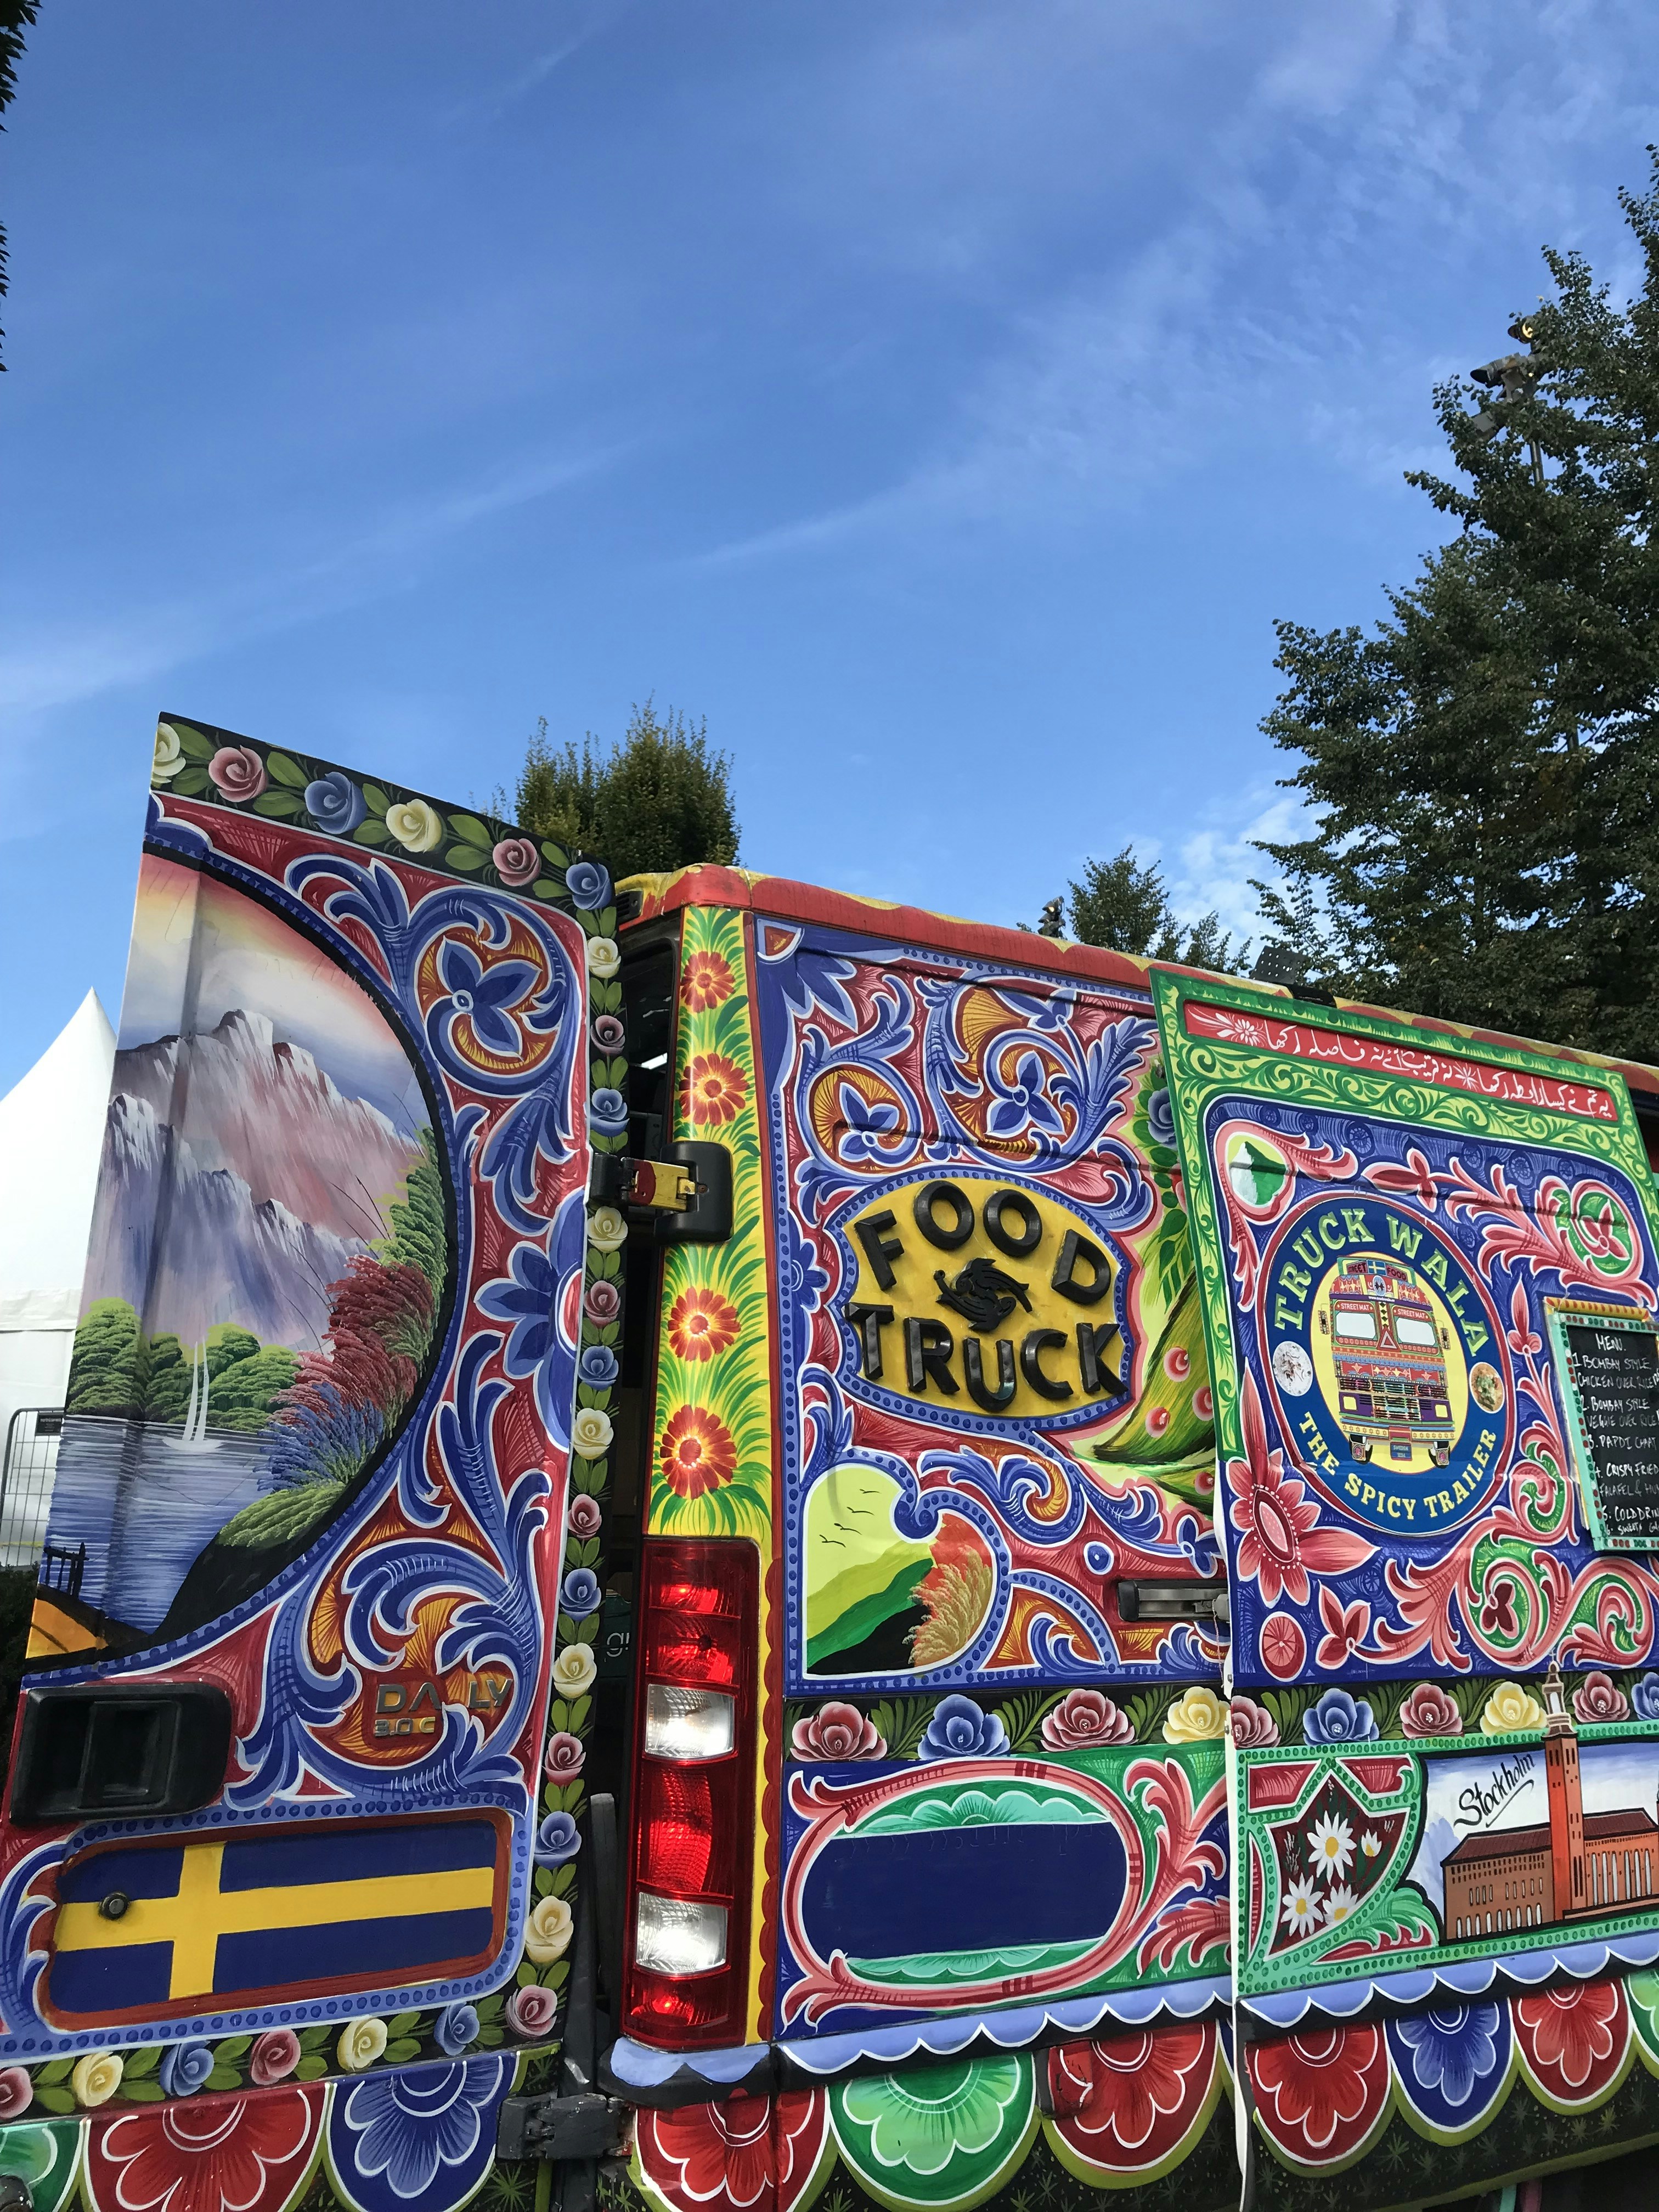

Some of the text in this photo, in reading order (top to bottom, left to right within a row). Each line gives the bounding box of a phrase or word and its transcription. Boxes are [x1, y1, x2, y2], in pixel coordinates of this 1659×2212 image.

[854, 1180, 1111, 1305] FOOD
[1274, 1208, 1490, 1358] TRUCK WALA
[1387, 1267, 1407, 1282] FOOD
[1397, 1308, 1414, 1317] STREET
[844, 1301, 1130, 1412] TRUCK
[1582, 1355, 1621, 1371] BOMBAY
[1624, 1357, 1651, 1370] STYLE
[1577, 1372, 1614, 1388] CHICKEN
[1616, 1376, 1637, 1389] OVER
[1637, 1376, 1654, 1389] RICE
[1591, 1396, 1623, 1413] BOMBAY
[1626, 1398, 1650, 1412] STYLE
[1599, 1435, 1633, 1449] PAPDI
[1299, 1411, 1497, 1521] THE SPICY TRAILER
[1606, 1463, 1634, 1477] CRISPY
[1635, 1462, 1659, 1476] FRIED
[1600, 1482, 1634, 1497] FALAFEL
[1453, 1754, 1536, 1827] Stockholm
